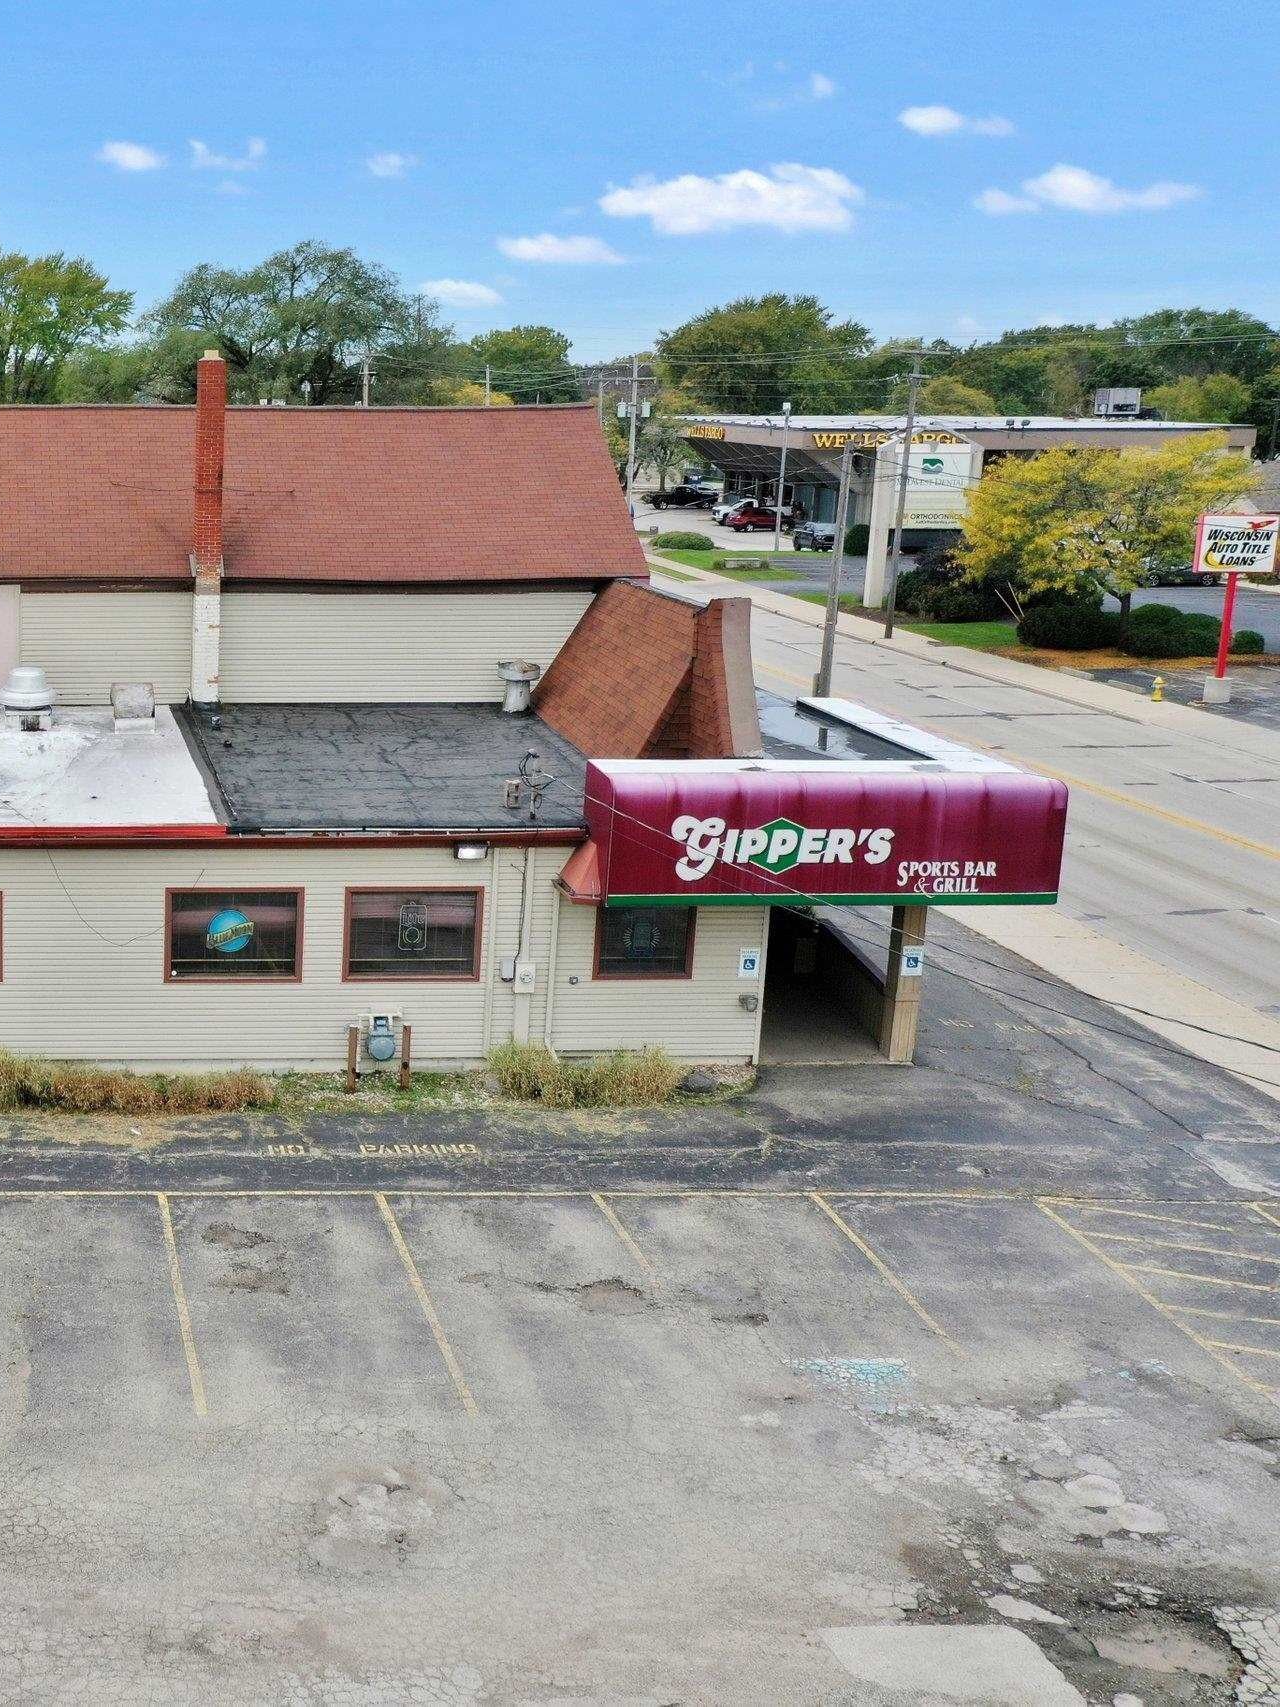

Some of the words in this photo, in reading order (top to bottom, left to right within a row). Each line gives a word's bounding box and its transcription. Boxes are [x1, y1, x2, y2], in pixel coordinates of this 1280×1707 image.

[812, 432, 890, 448] WELLS
[1207, 529, 1273, 541] WISCONSIN
[1211, 542, 1238, 554] AUTO
[1240, 542, 1270, 554] TITLE
[1220, 555, 1256, 566] LOANS
[670, 814, 896, 882] GIPPER'S
[896, 861, 960, 887] SPORTS
[963, 861, 997, 877] BAR
[913, 877, 936, 899] &
[932, 877, 980, 893] GRILL
[267, 1144, 305, 1156] NO
[358, 1143, 477, 1155] PARKING
